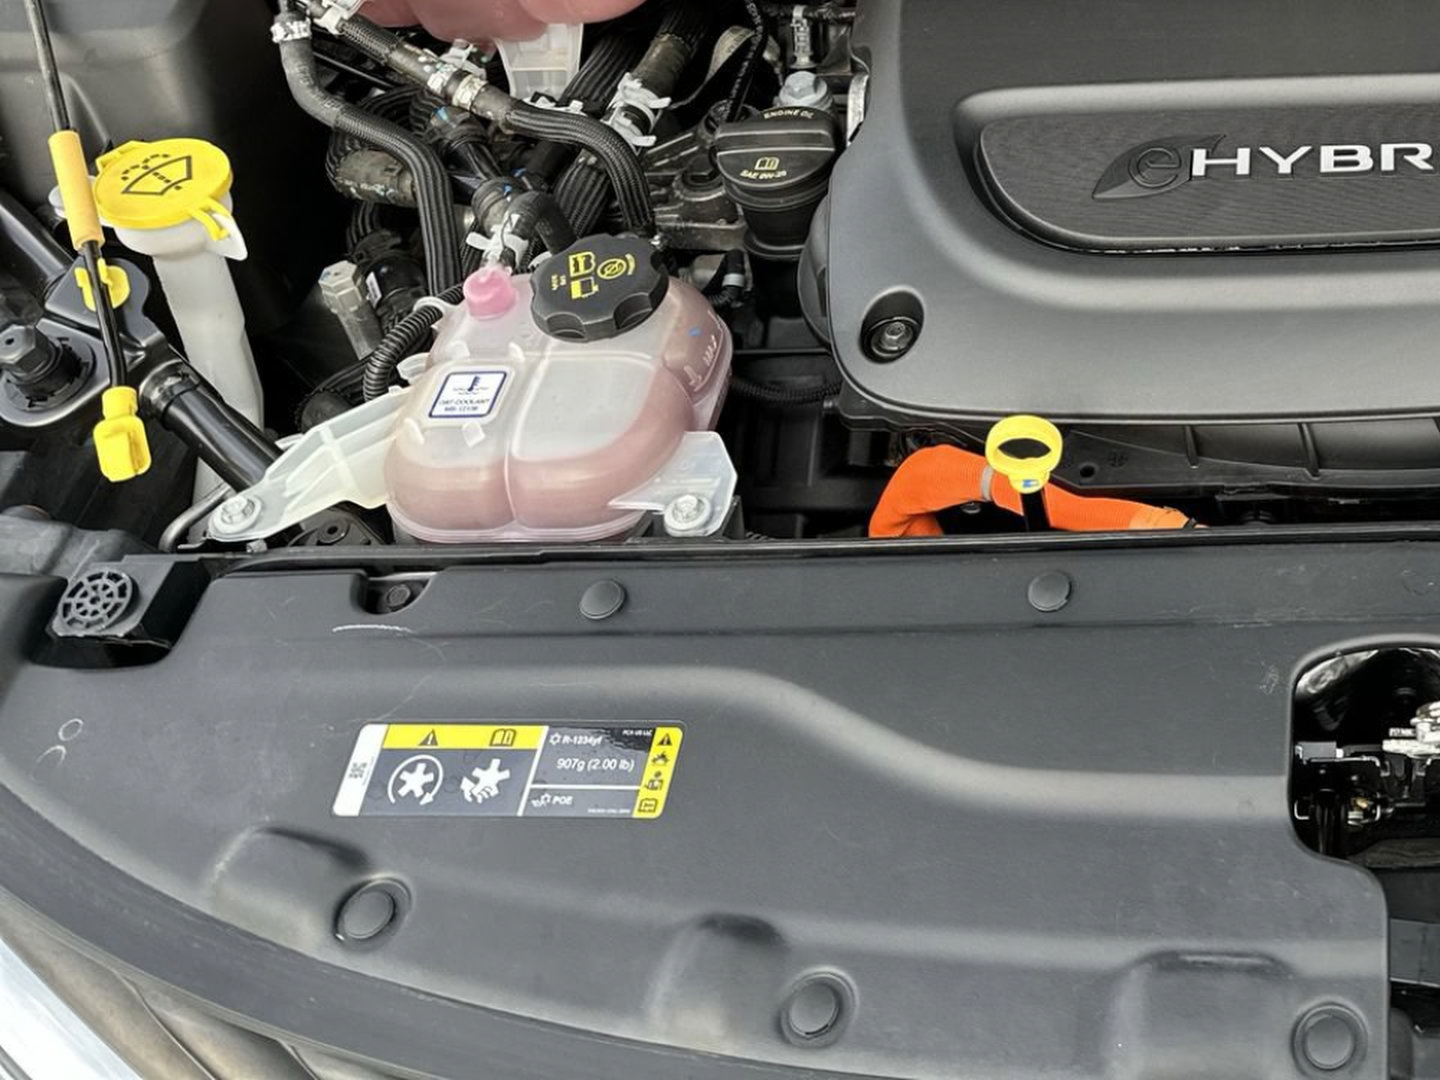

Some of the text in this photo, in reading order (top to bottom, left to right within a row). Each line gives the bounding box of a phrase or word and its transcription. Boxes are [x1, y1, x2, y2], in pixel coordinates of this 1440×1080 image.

[763, 108, 815, 120] ENGINE OIL
[740, 169, 788, 180] SAE 0W-20
[562, 734, 603, 747] R-1234yf
[556, 758, 635, 773] 907g (2.00 lb)
[551, 795, 573, 806] POE
